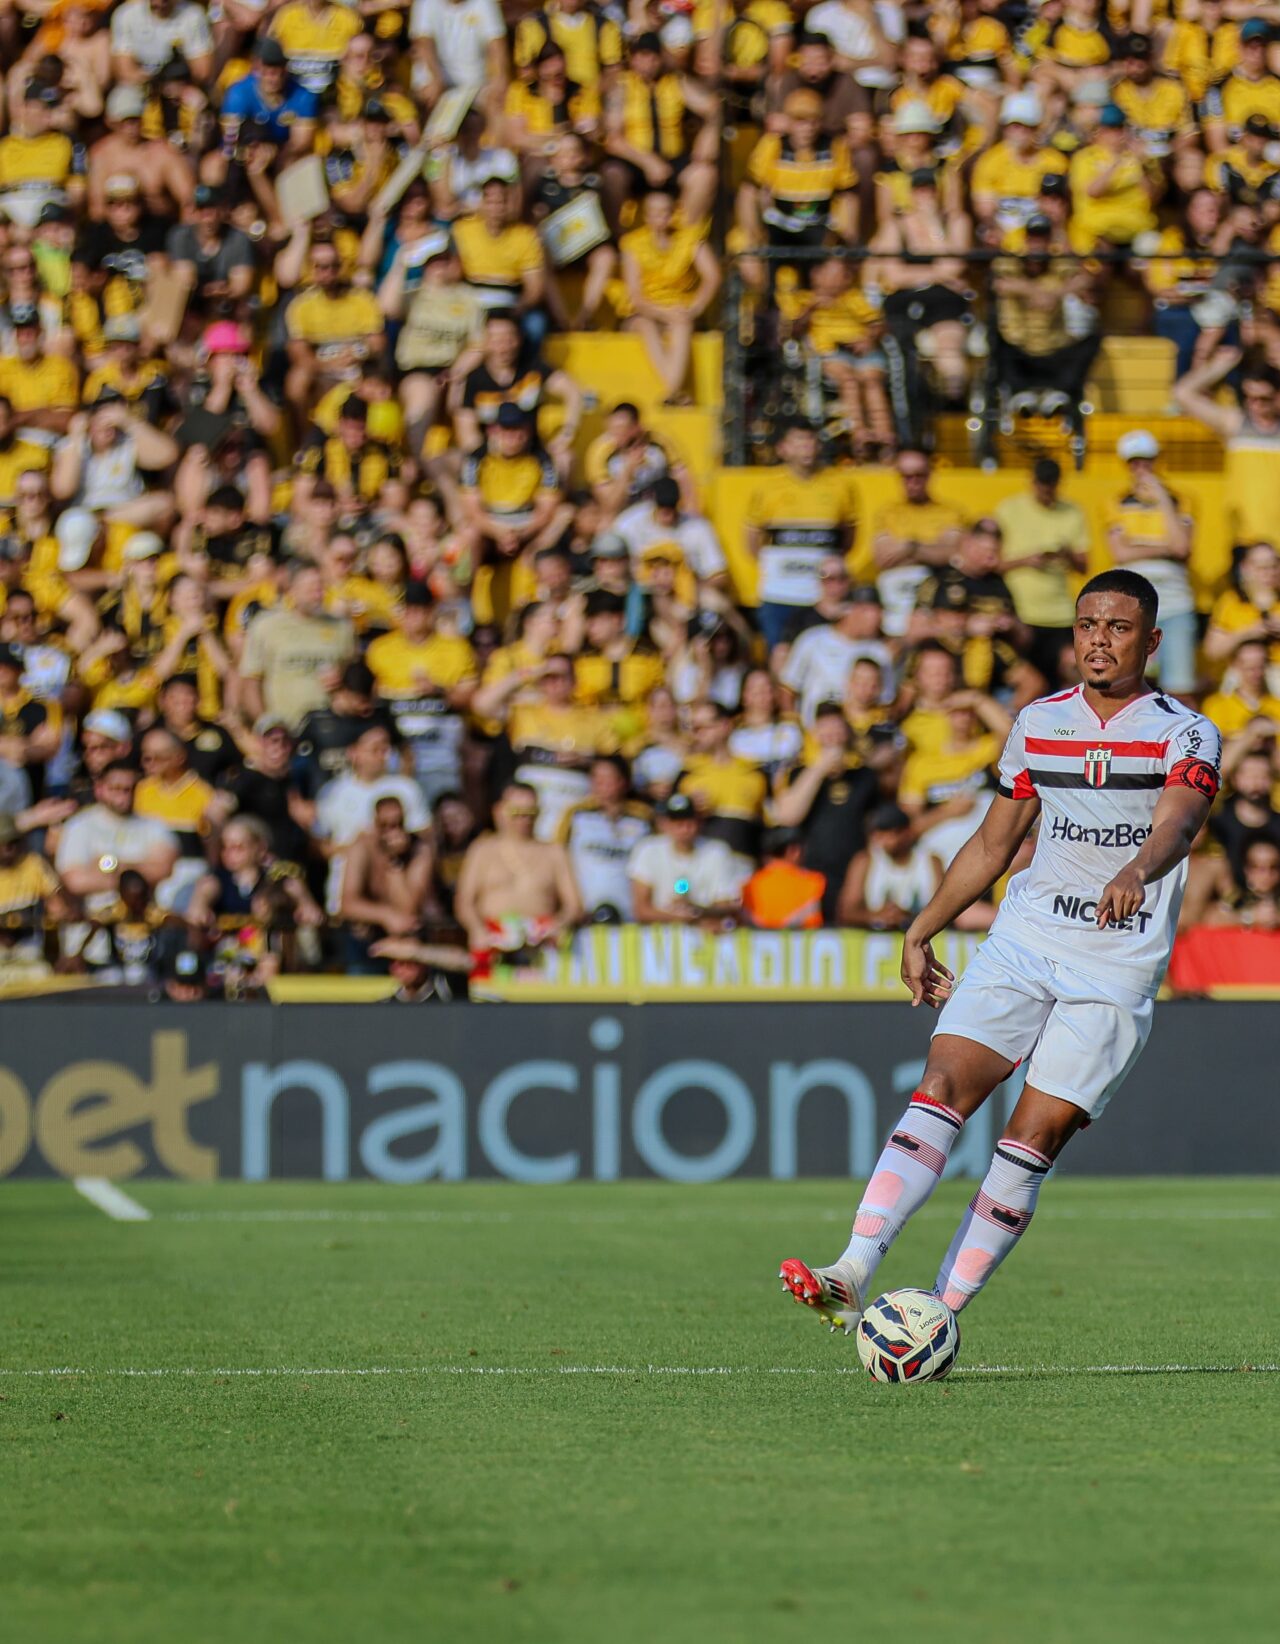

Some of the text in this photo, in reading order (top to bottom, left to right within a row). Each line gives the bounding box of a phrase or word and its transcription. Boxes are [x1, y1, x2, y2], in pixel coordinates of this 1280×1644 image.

[1053, 728, 1076, 736] VOLT
[1052, 894, 1153, 934] NICET
[919, 1312, 945, 1330] uhlsport
